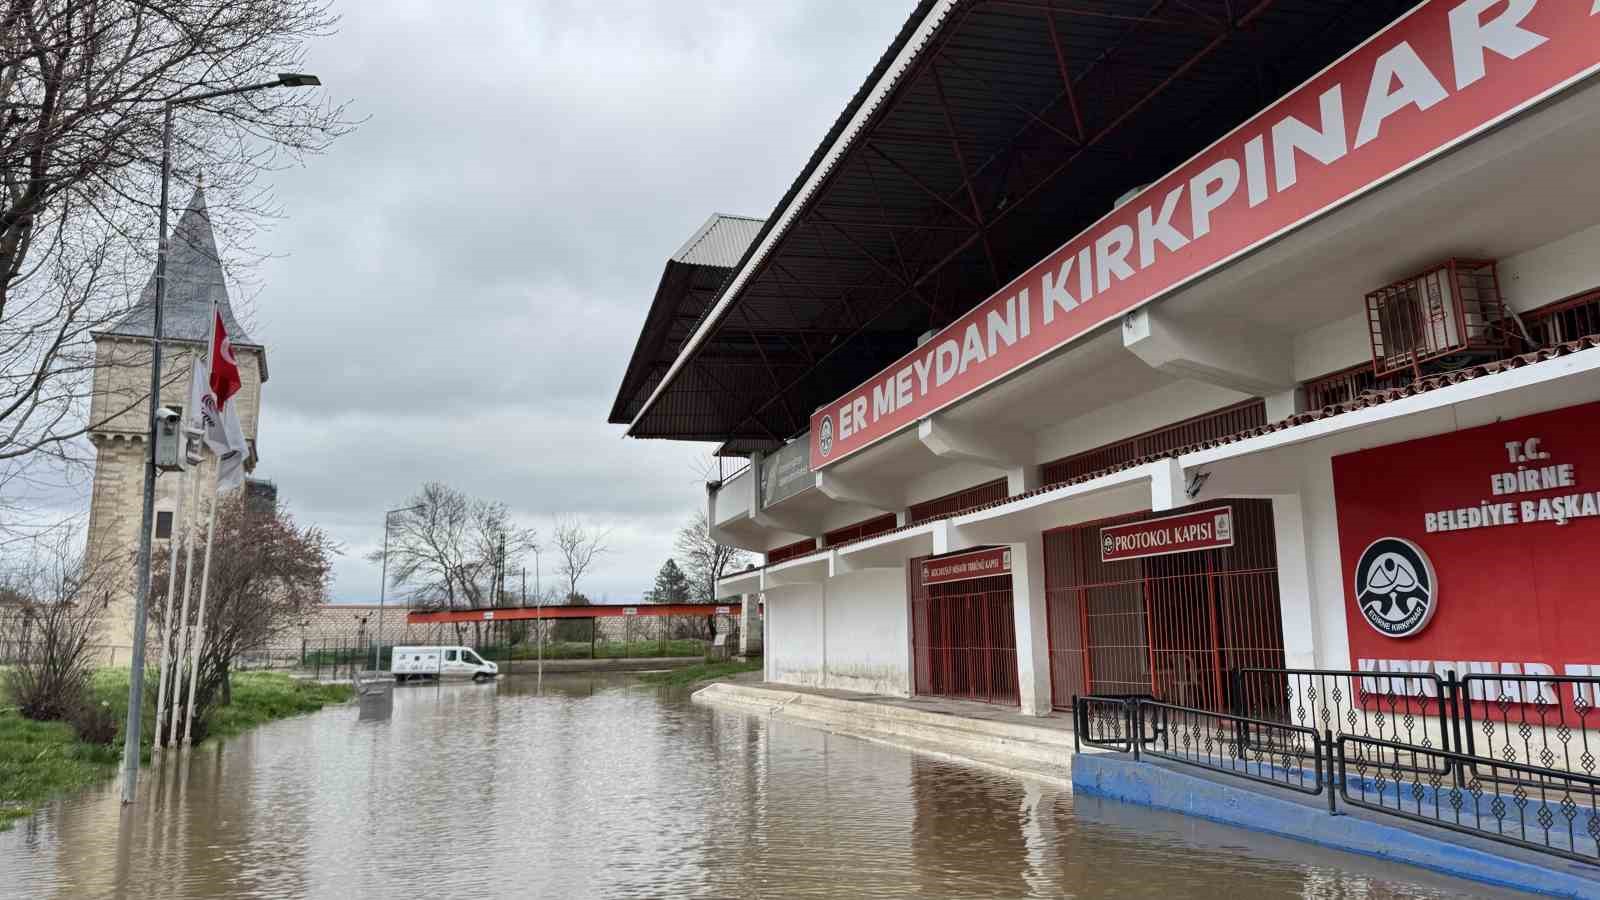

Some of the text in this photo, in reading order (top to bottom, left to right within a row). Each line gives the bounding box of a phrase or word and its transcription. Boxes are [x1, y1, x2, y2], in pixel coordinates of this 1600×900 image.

[839, 0, 1550, 440] ER MEYDANI KIRKPINAR
[1505, 437, 1550, 463] T.C.
[1491, 464, 1575, 495] EDİRNE
[1424, 491, 1600, 533] BELEDİYE BAŞKA
[1115, 522, 1212, 551] PROTOKOL KAPISI
